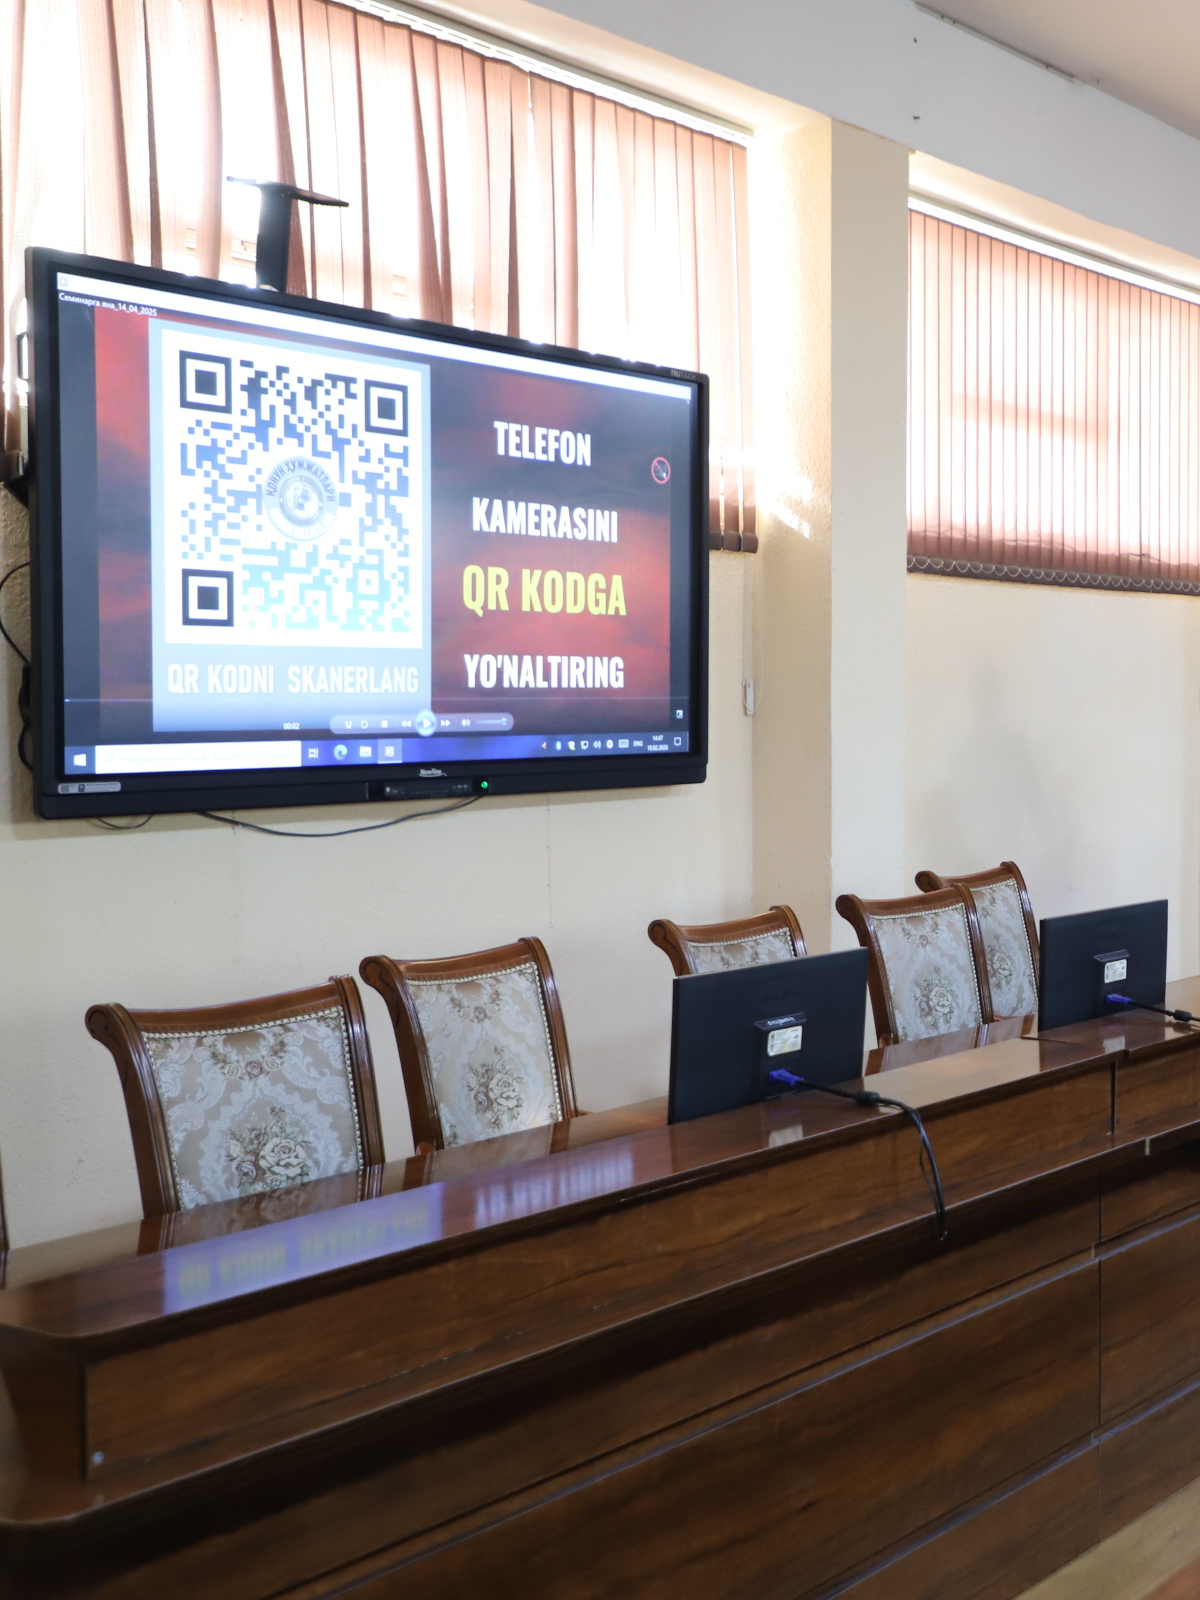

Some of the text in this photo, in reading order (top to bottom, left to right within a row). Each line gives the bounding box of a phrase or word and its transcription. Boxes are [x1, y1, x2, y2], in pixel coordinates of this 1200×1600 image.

[493, 420, 592, 467] TELEFON
[472, 496, 619, 544] KAMERASINI
[462, 564, 627, 617] QR KODGA
[167, 664, 420, 695] QR KODNI SKANERLANG
[463, 653, 625, 689] YO'NALTIRING
[283, 722, 300, 730] 00:02
